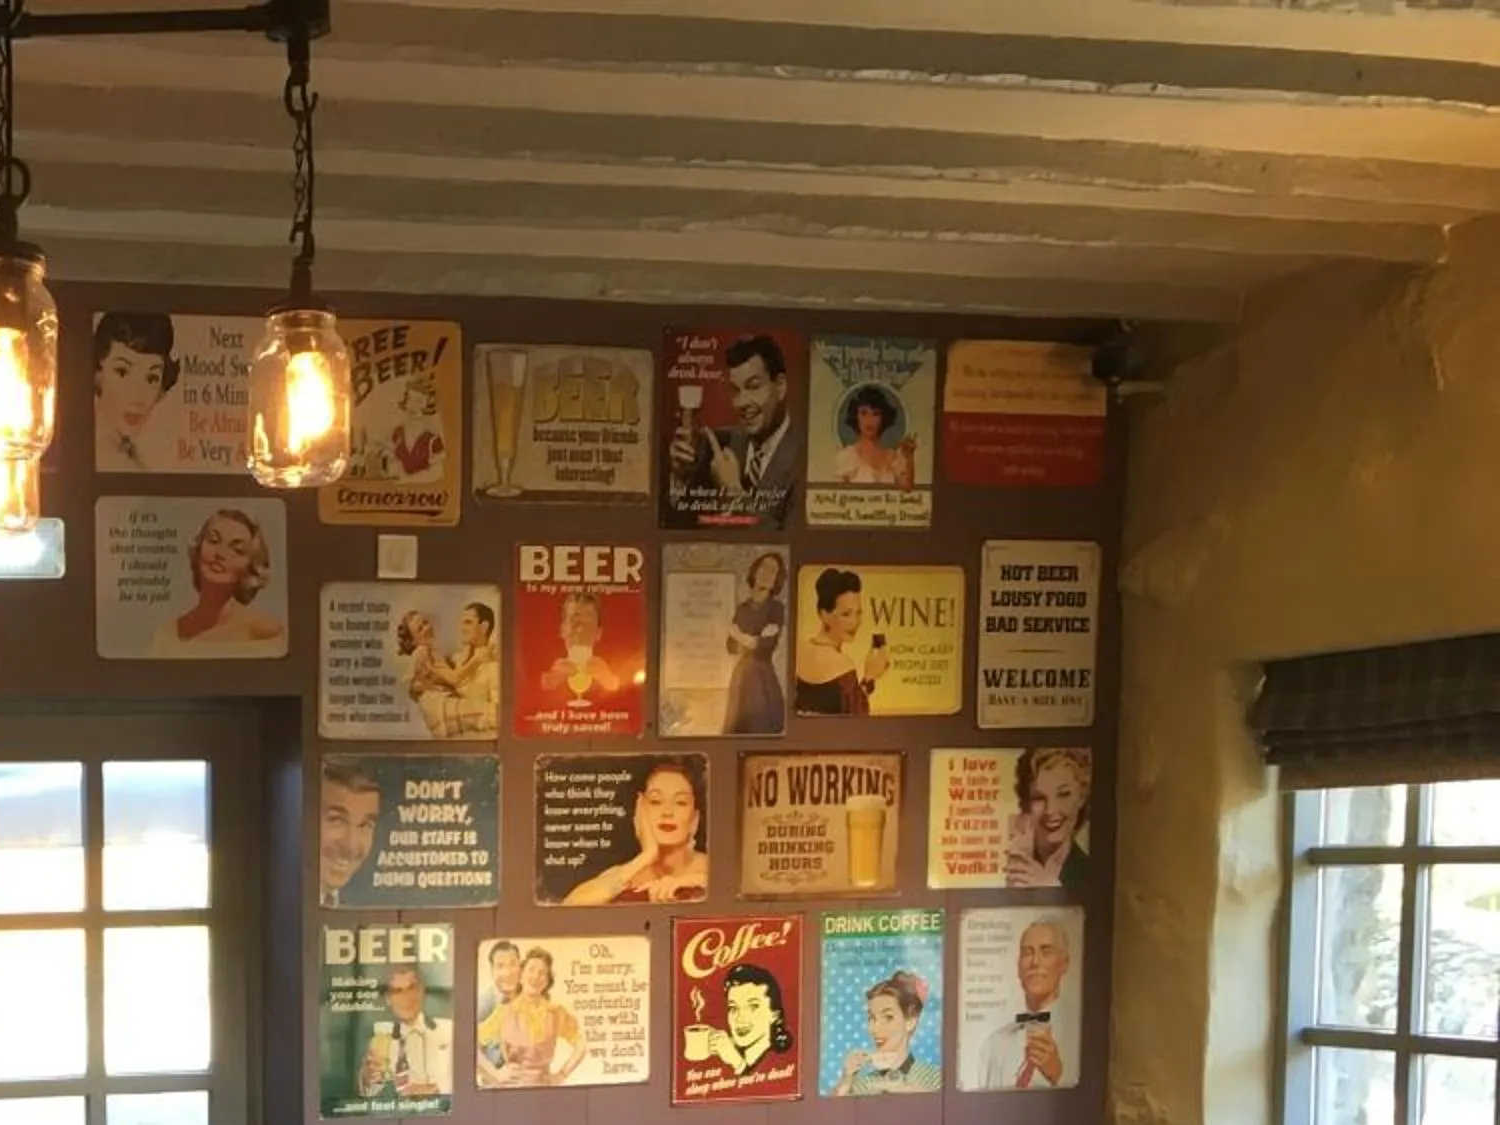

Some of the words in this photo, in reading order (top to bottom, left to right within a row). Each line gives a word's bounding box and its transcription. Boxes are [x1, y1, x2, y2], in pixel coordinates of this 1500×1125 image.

[209, 325, 244, 349] Next
[344, 325, 412, 362] REE
[184, 354, 226, 377] Mood
[183, 383, 198, 405] in
[201, 385, 210, 405] 6
[199, 440, 233, 466] Very
[519, 545, 644, 583] BEER
[1000, 565, 1034, 581] HOT
[1037, 565, 1079, 582] BEER
[991, 590, 1042, 607] LOUSY
[1045, 591, 1087, 608] FOOD
[870, 596, 955, 627] WINE!
[986, 617, 1018, 633] BAD
[1023, 617, 1090, 633] SERVICE
[982, 668, 1092, 689] WELCOME
[405, 780, 464, 800] DON'T
[748, 769, 778, 808] NO
[787, 763, 895, 807] WORKING
[398, 802, 475, 827] WORRY,
[420, 830, 462, 846] STAFF
[767, 825, 827, 838] DURING
[377, 850, 468, 866] ACCUSTOMED
[471, 850, 489, 866] TO
[757, 840, 835, 855] DRINKING
[769, 857, 822, 870] HOURS
[825, 916, 875, 934] DRINK
[878, 913, 941, 932] COFFEE
[324, 928, 449, 965] BEER
[681, 921, 793, 979] Coffee!
[612, 1027, 645, 1041] maid
